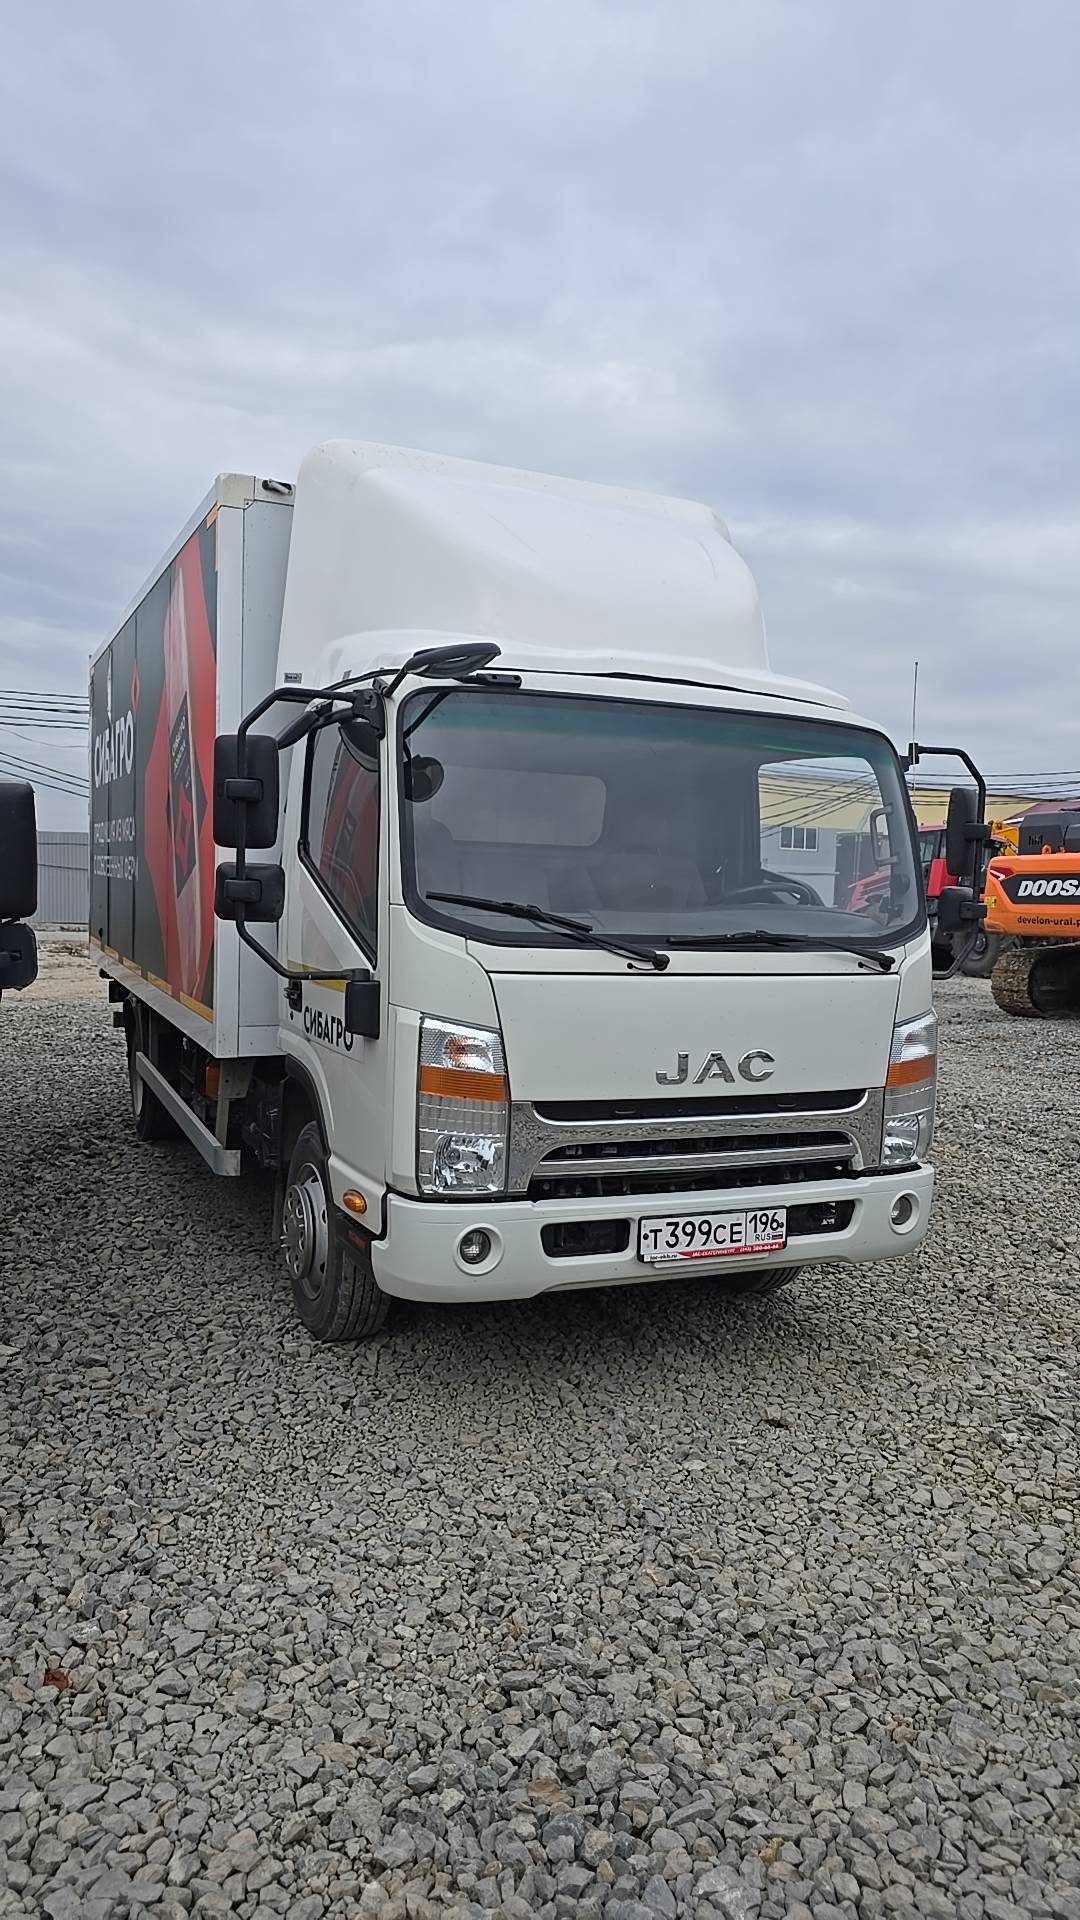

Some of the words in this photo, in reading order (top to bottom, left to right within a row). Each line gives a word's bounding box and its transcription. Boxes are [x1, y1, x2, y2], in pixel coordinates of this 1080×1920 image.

[94, 710, 134, 789] СИБАГРО
[304, 1006, 353, 1051] СИБАГРО
[656, 1049, 775, 1085] JAC
[650, 1220, 743, 1249] Т399СЕ
[749, 1212, 780, 1233] 196
[755, 1233, 771, 1241] RUS
